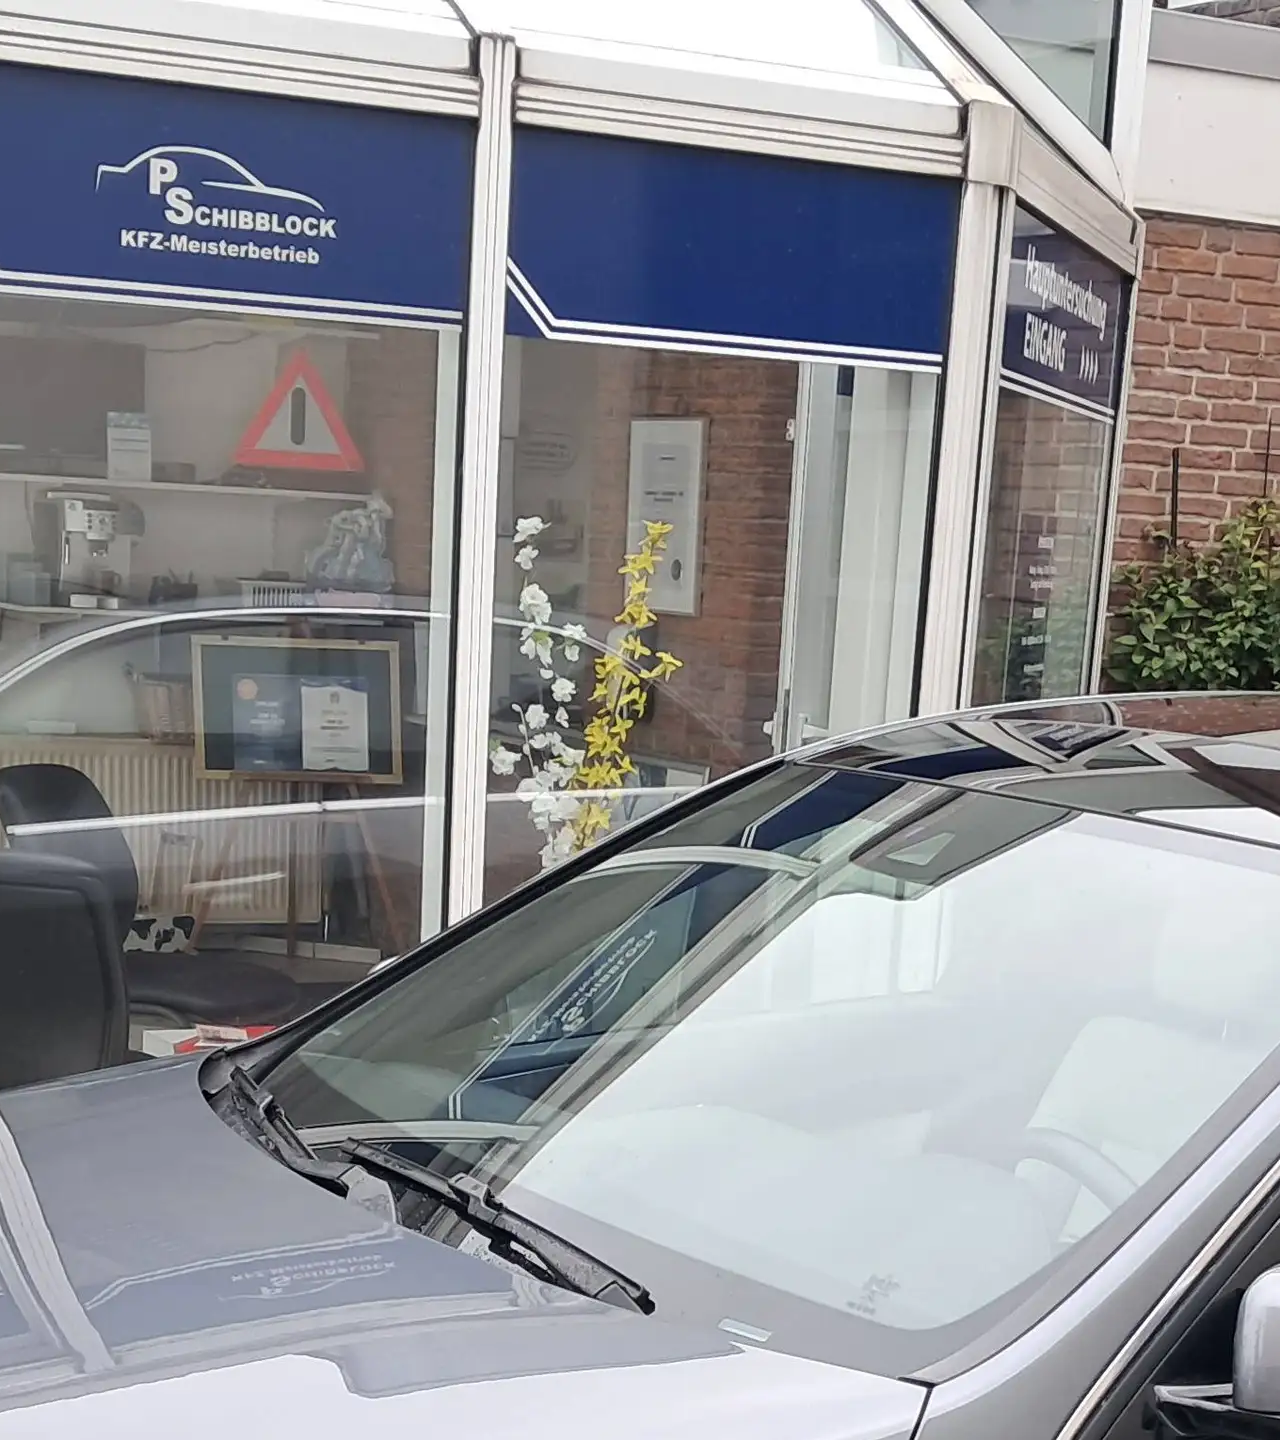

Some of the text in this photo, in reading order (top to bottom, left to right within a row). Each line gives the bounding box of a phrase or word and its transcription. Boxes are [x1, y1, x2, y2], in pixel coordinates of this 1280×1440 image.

[120, 229, 320, 265] KFZ-Meisterbetrieb
[1024, 243, 1108, 342] Hauptuntersuchung
[1023, 311, 1067, 372] EINGANG
